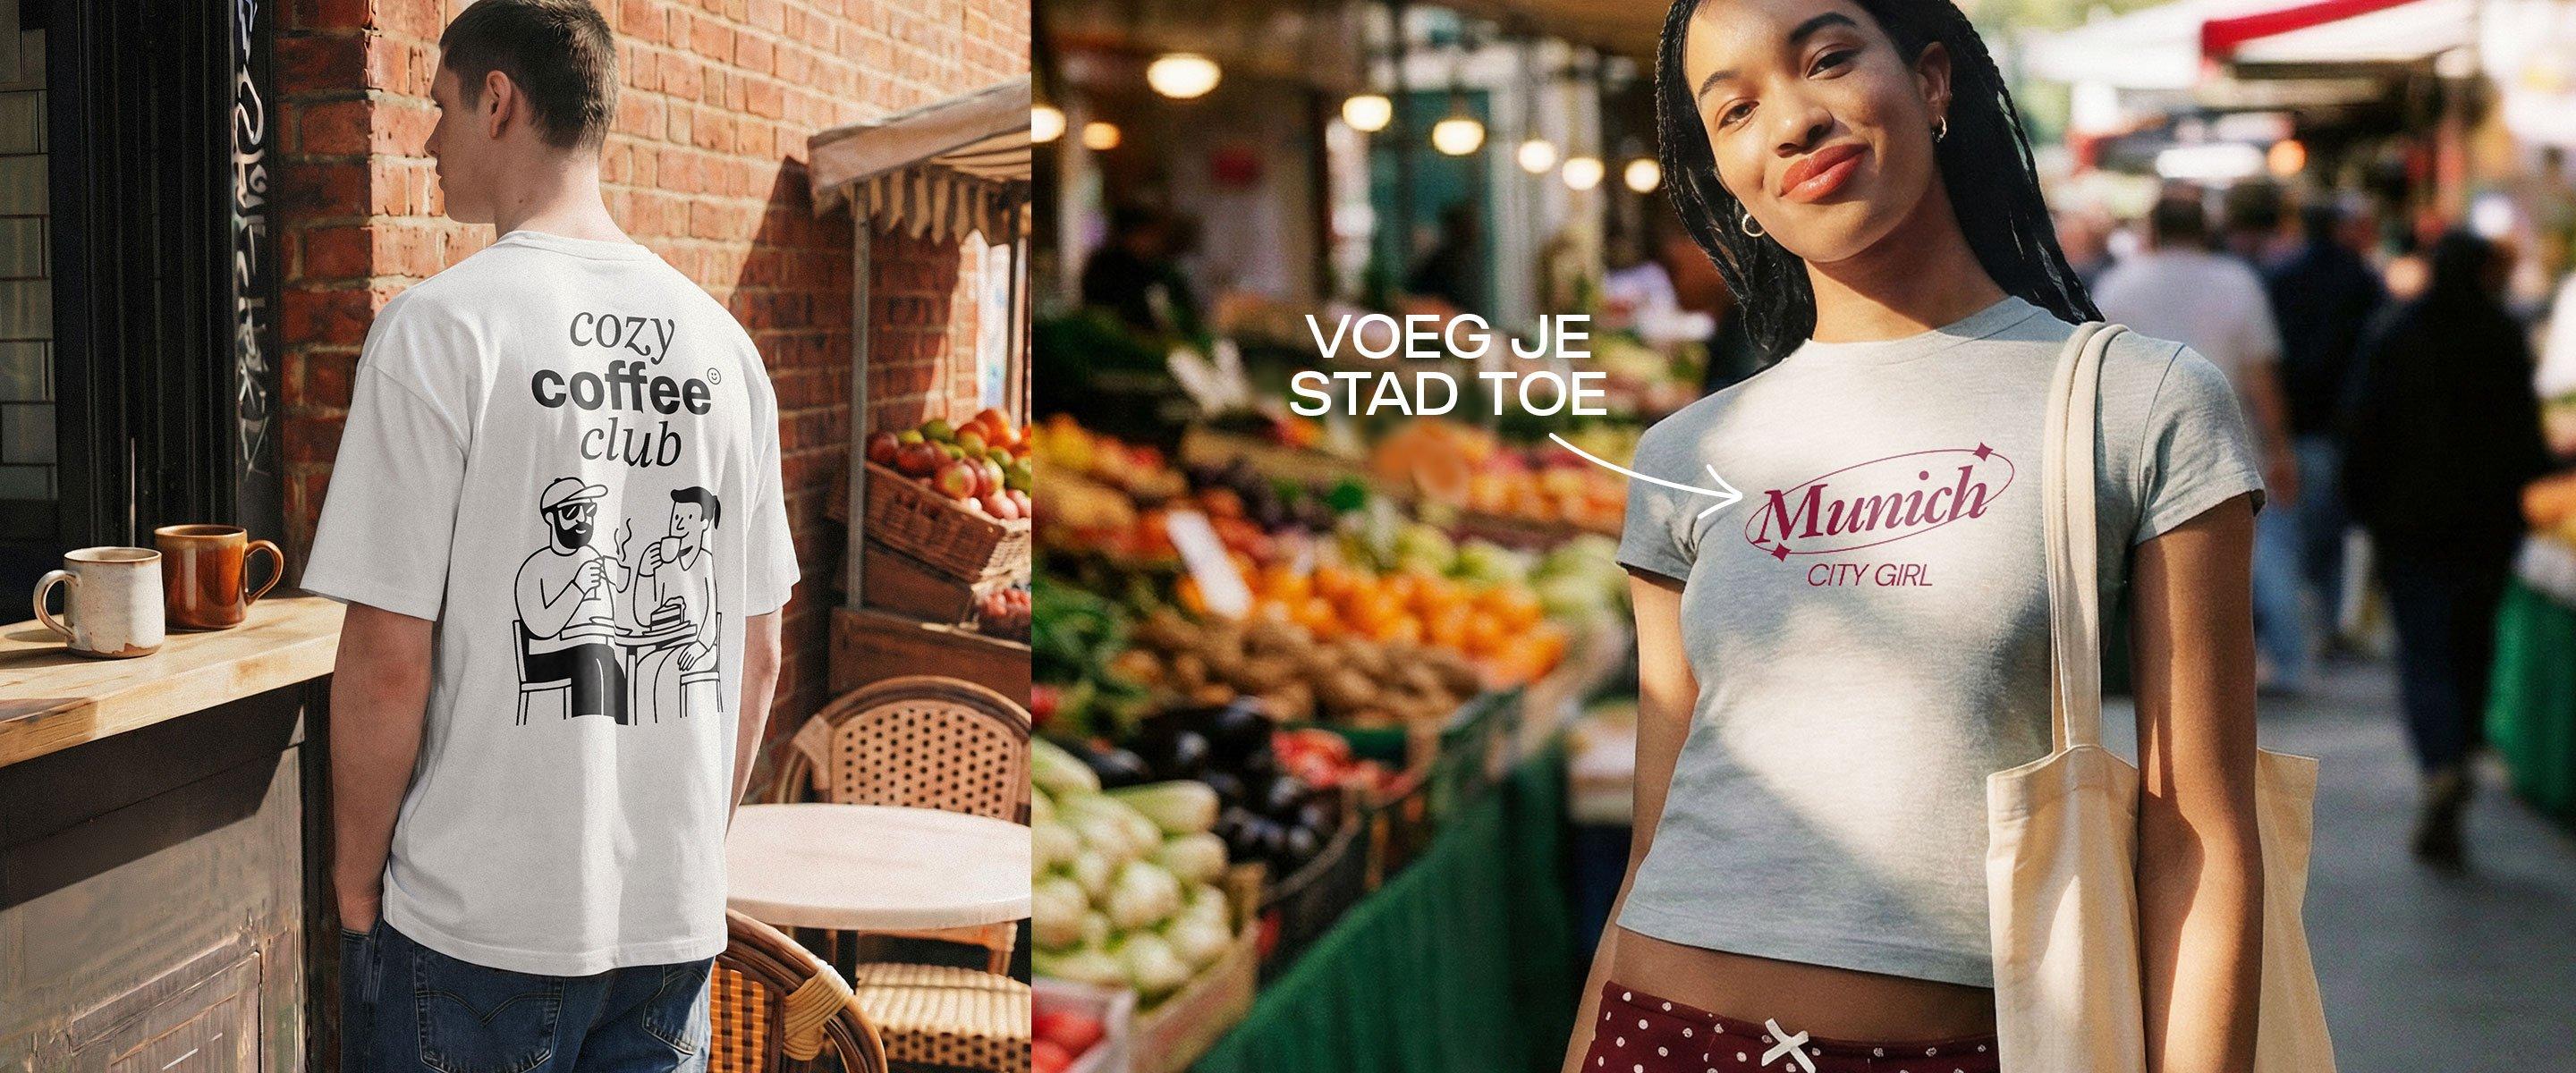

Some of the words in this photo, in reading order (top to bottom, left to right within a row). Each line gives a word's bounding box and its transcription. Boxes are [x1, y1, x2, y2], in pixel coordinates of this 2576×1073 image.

[570, 312, 675, 365] cozy
[531, 359, 712, 415] coffee
[580, 417, 682, 468] club
[1753, 465, 1988, 544] Munich
[1807, 563, 1869, 587] CITY
[1875, 563, 1934, 587] GIRL
